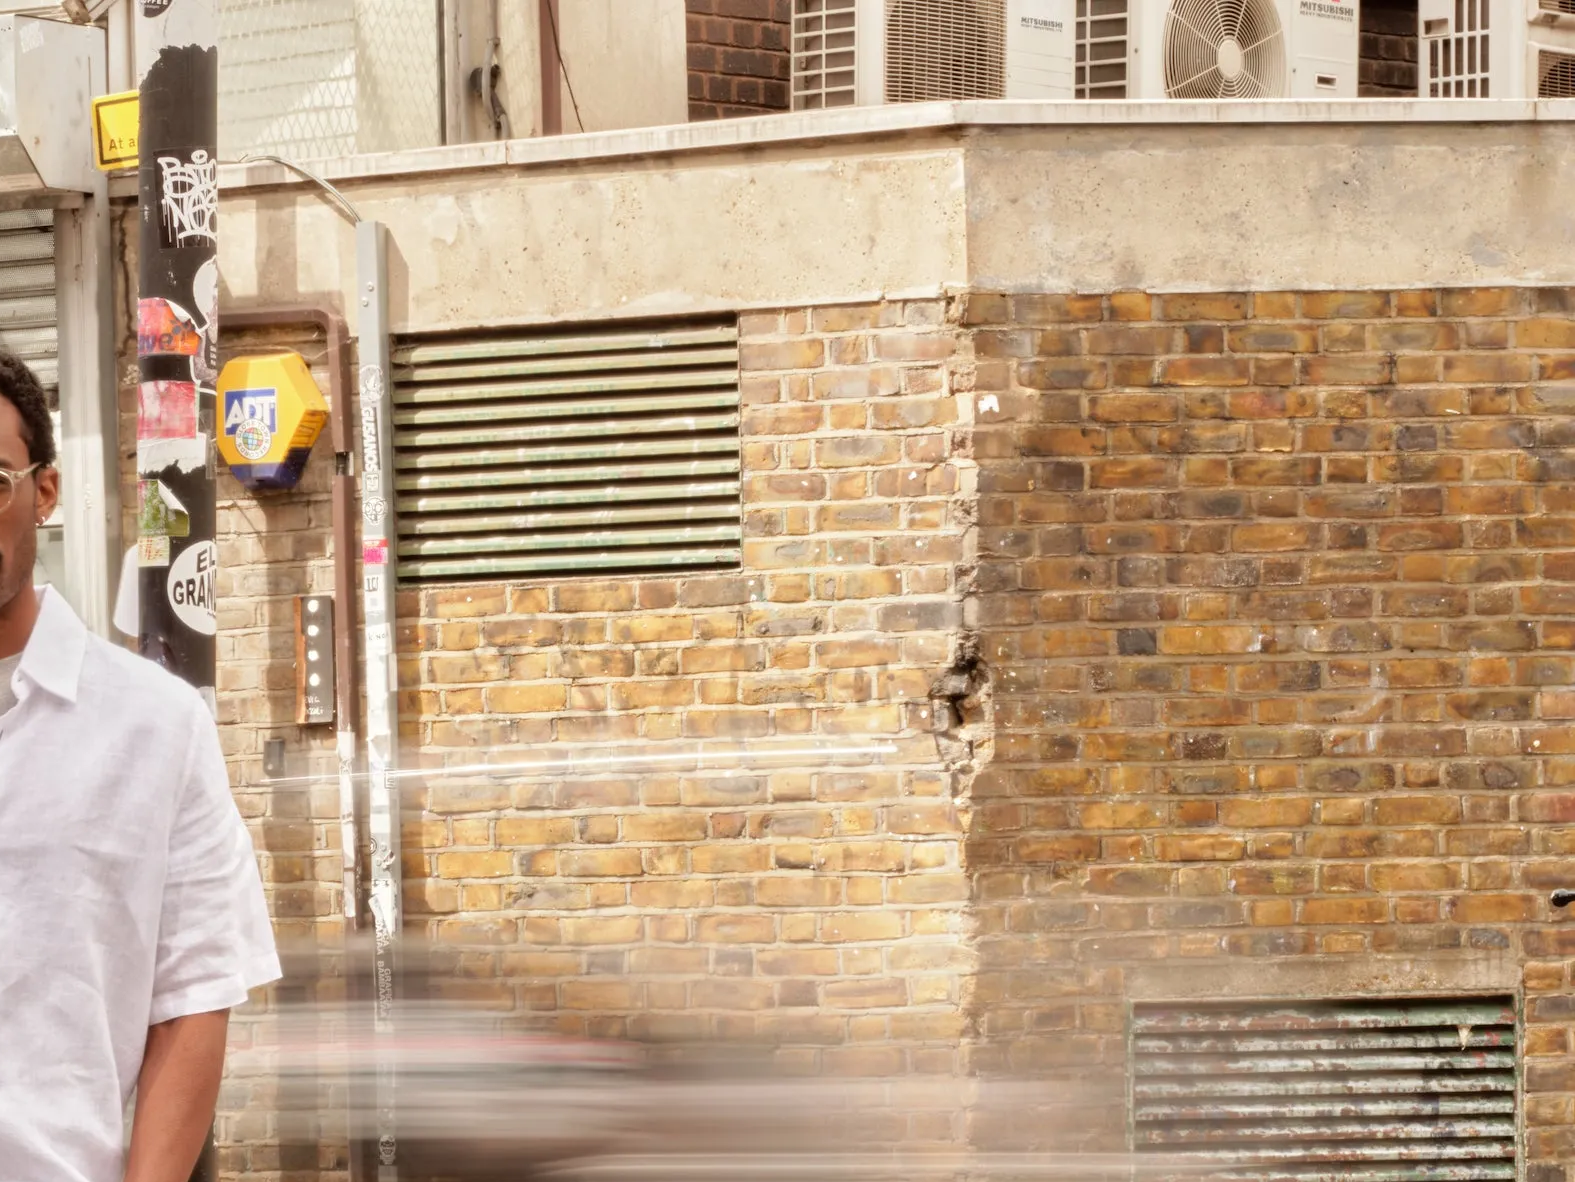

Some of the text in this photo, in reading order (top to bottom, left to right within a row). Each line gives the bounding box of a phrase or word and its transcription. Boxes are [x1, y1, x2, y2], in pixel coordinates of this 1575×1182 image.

[1300, 0, 1354, 17] MITSUBISHI
[1021, 17, 1063, 29] MITSUBISHI
[109, 138, 123, 151] At
[226, 396, 276, 428] ADT
[197, 546, 216, 573] EL
[174, 568, 216, 612] GRAN
